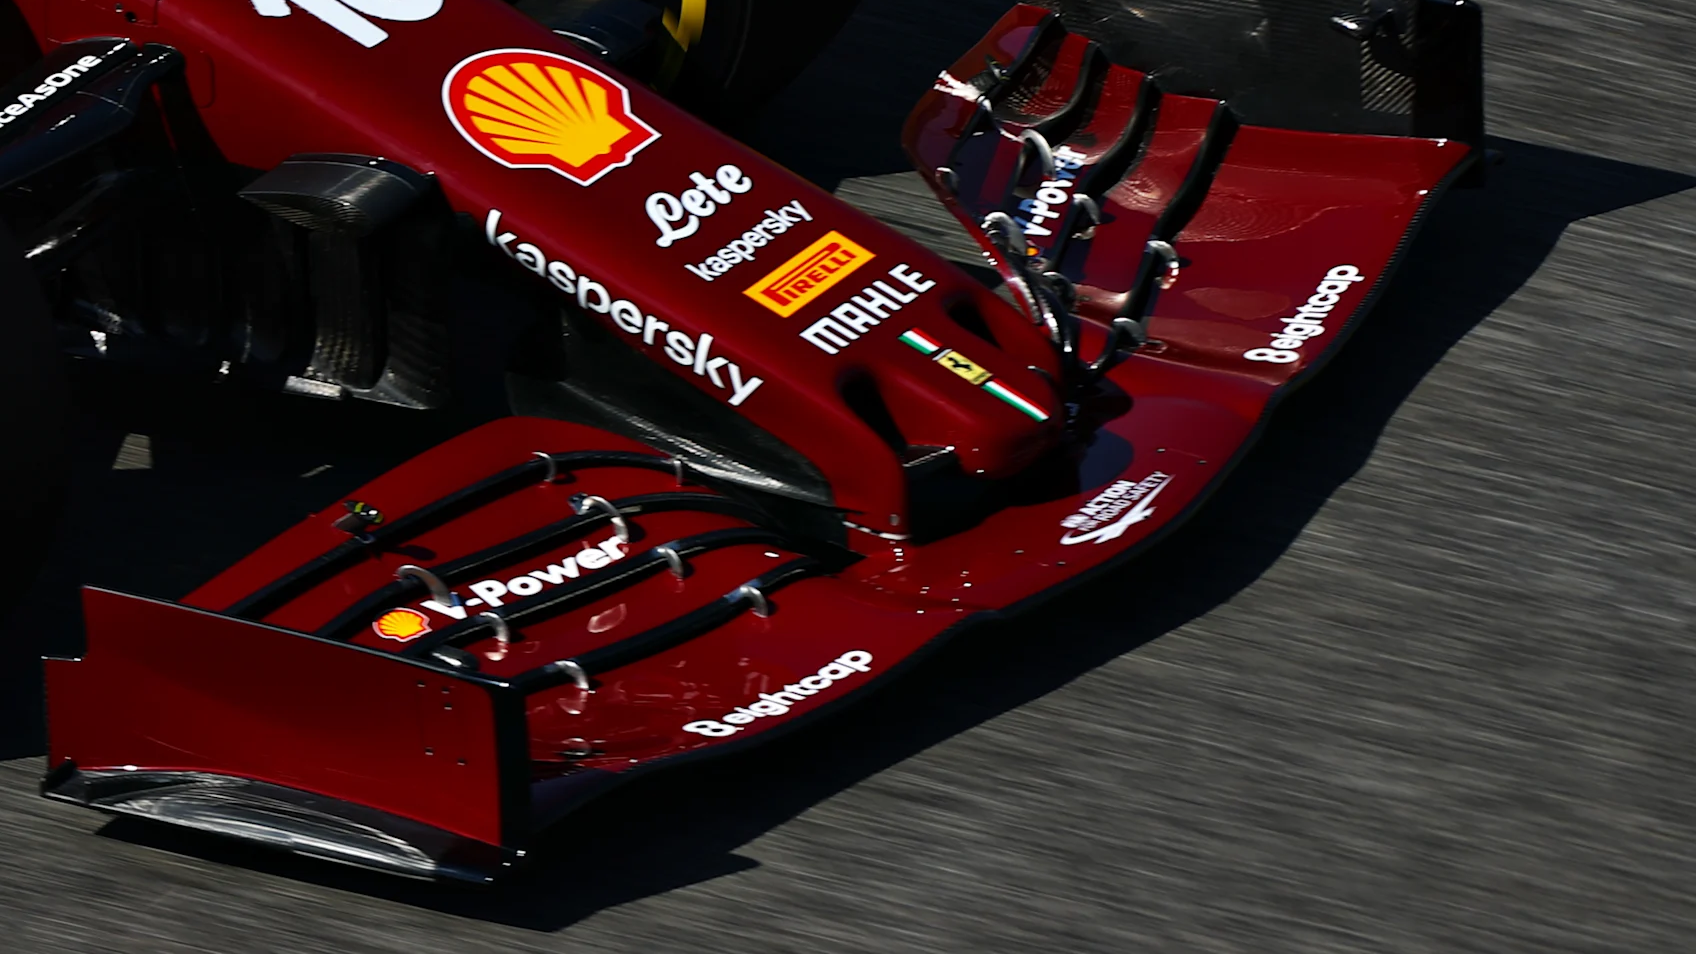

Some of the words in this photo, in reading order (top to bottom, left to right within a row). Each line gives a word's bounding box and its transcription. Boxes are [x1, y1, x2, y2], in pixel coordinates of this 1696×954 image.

[645, 164, 753, 247] Lete
[684, 199, 814, 282] kaspersky
[485, 208, 764, 407] kaspersky
[759, 242, 857, 307] PIRELLI
[798, 263, 937, 355] MAHLE
[1078, 479, 1138, 517] ACTION
[1122, 470, 1170, 501] SAFETY
[420, 535, 626, 620] V-Power
